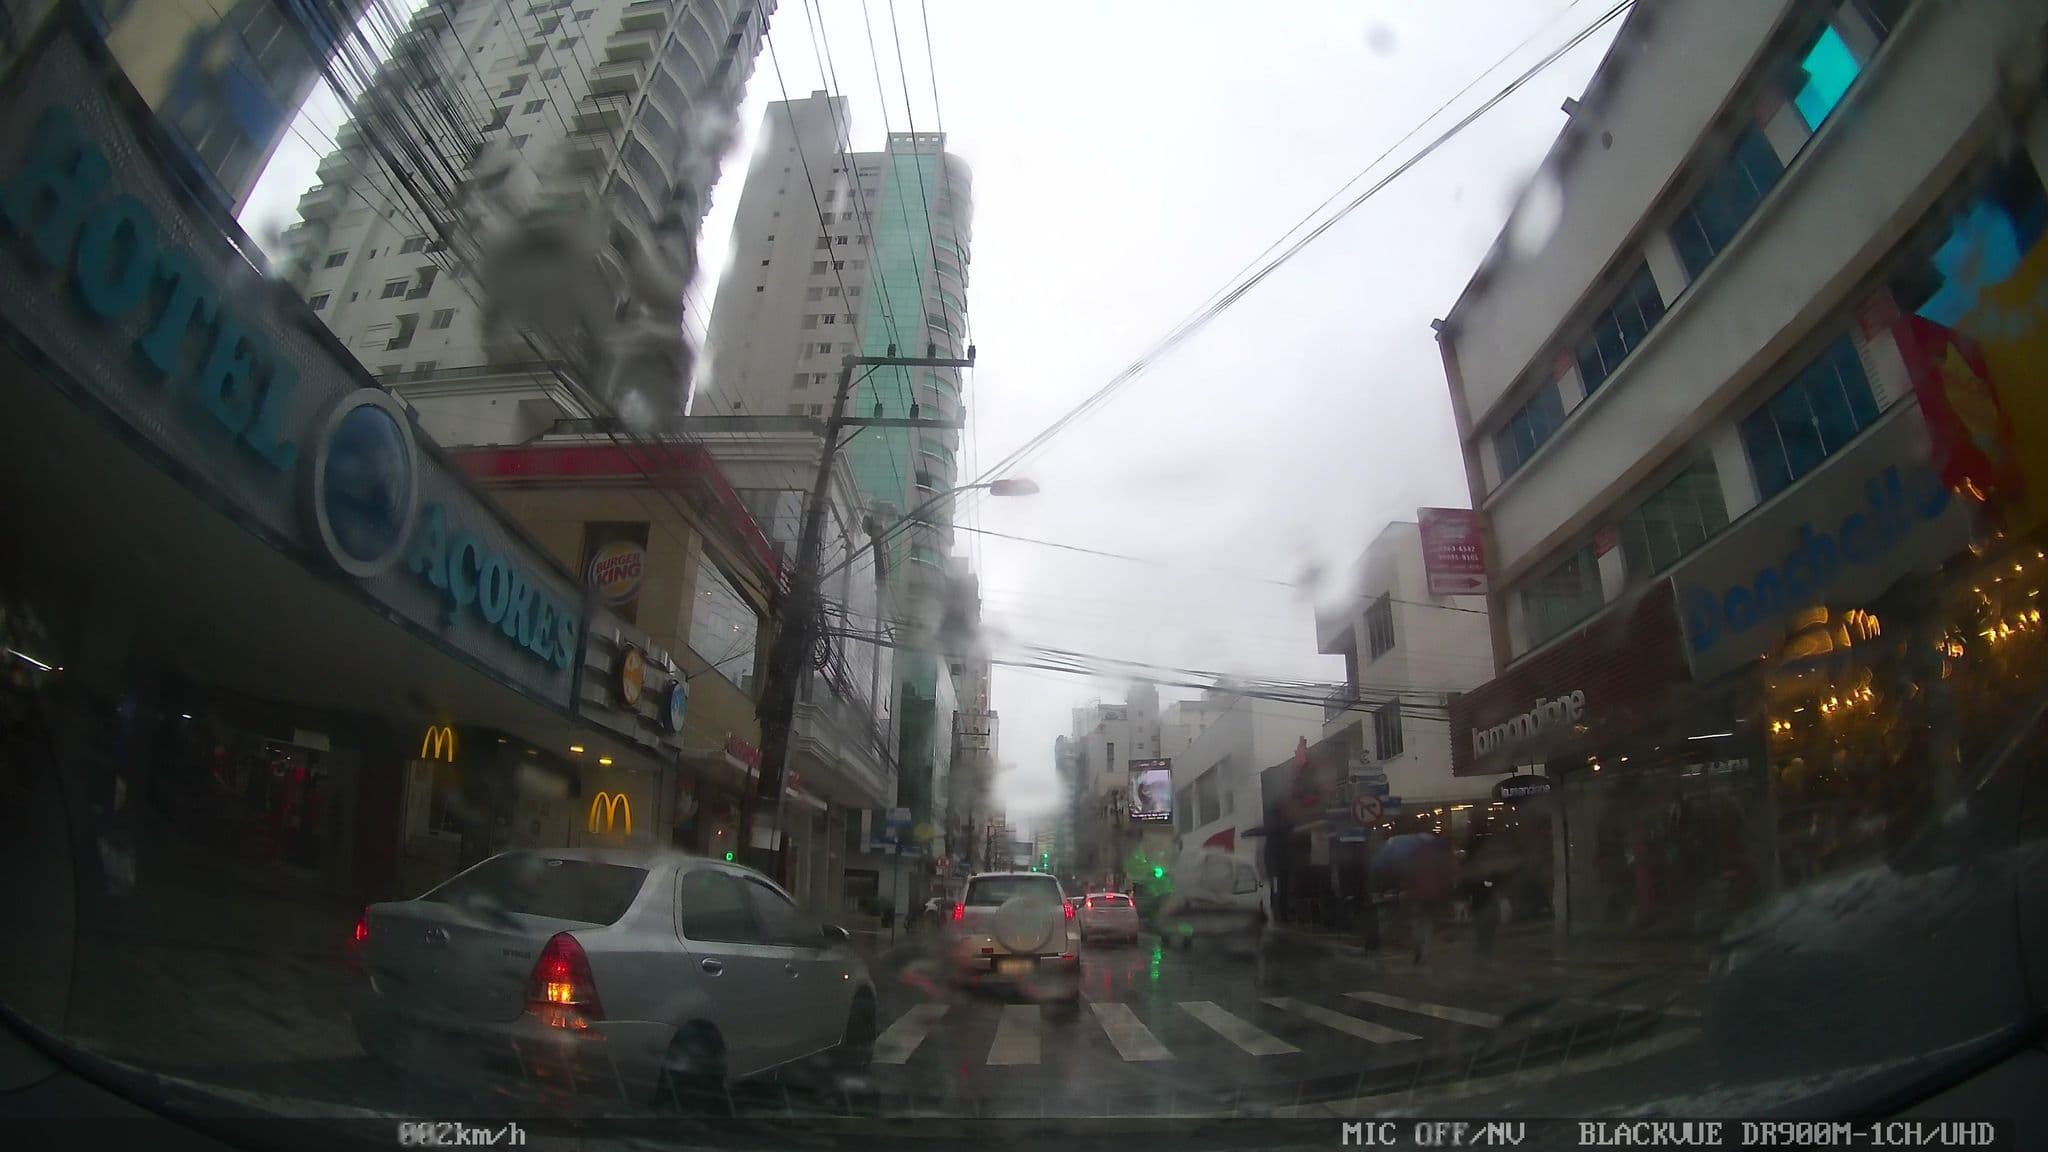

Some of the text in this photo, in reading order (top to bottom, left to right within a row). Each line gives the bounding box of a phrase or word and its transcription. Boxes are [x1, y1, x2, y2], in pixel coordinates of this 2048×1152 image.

[0, 107, 297, 472] HOTEL
[408, 503, 577, 671] AÇORES
[596, 552, 641, 575] BURGER
[597, 563, 641, 585] KING
